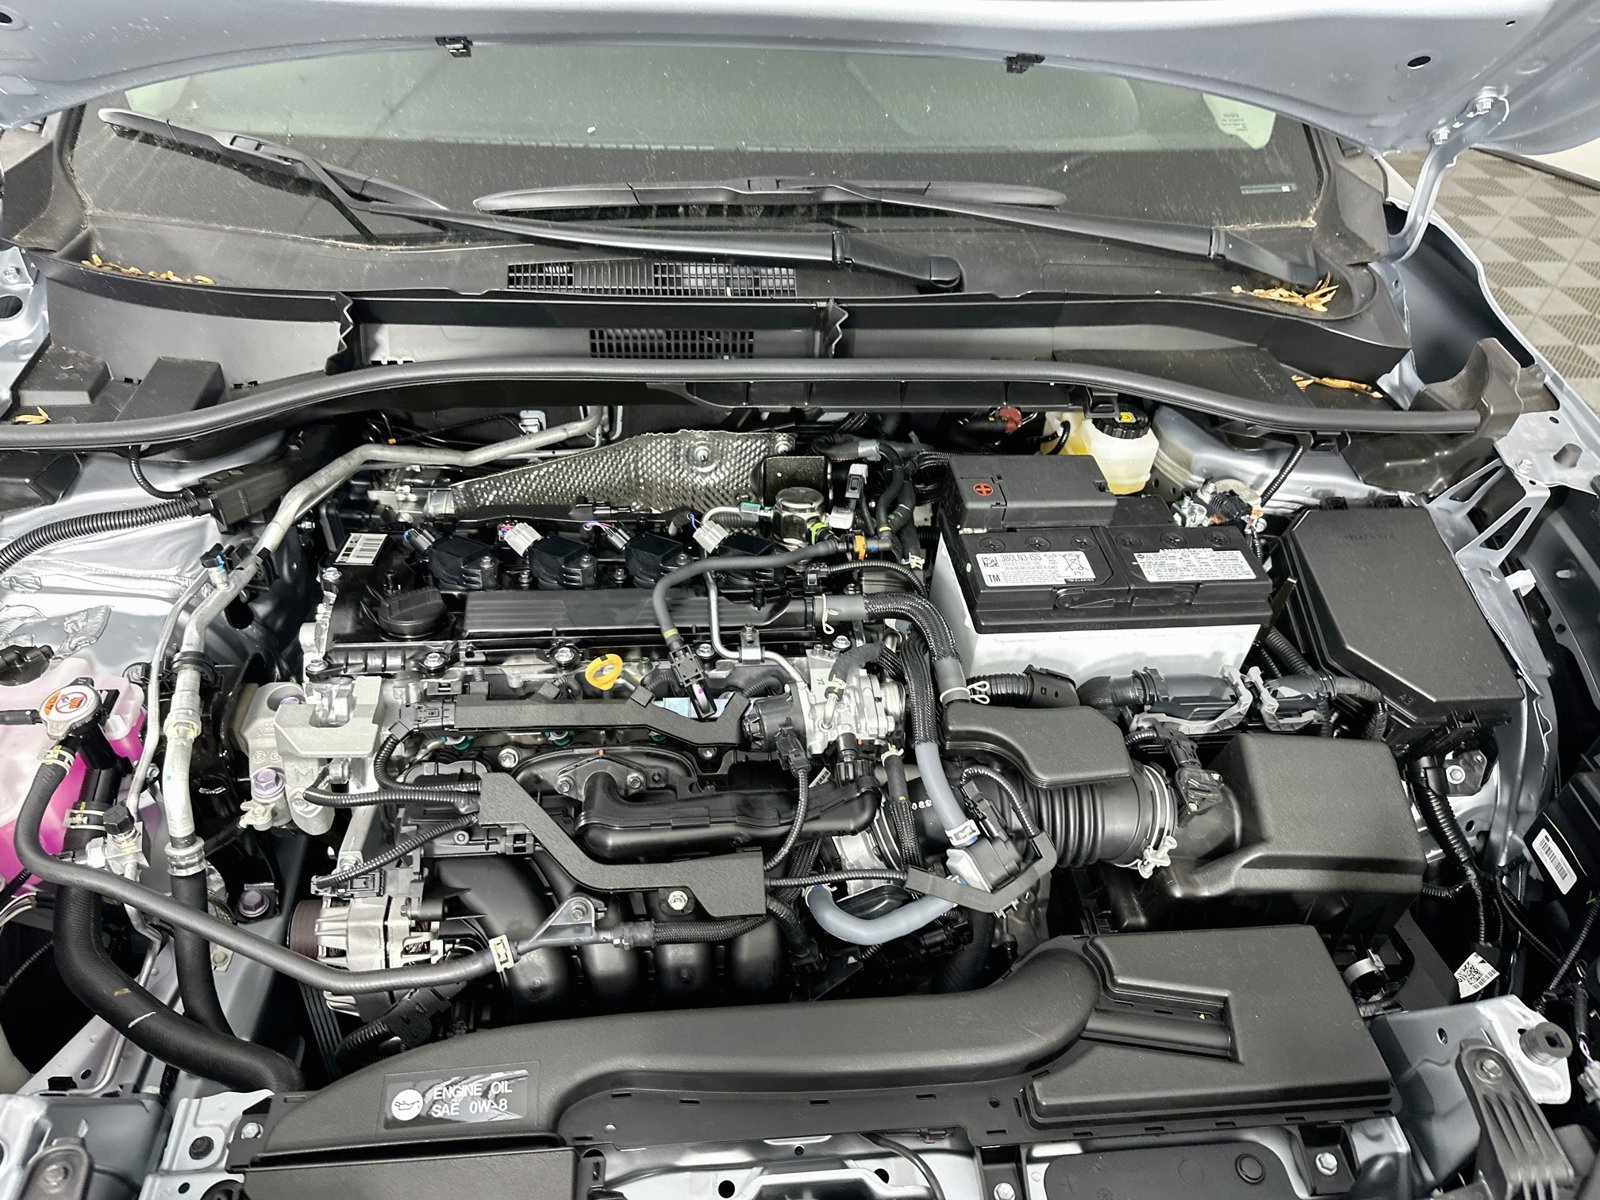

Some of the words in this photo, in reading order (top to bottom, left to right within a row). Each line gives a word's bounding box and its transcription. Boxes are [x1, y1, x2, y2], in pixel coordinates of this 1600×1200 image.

[987, 574, 1001, 583] TM
[433, 1083, 483, 1101] ENGINE
[490, 1080, 513, 1095] OIL
[431, 1102, 460, 1118] SAE
